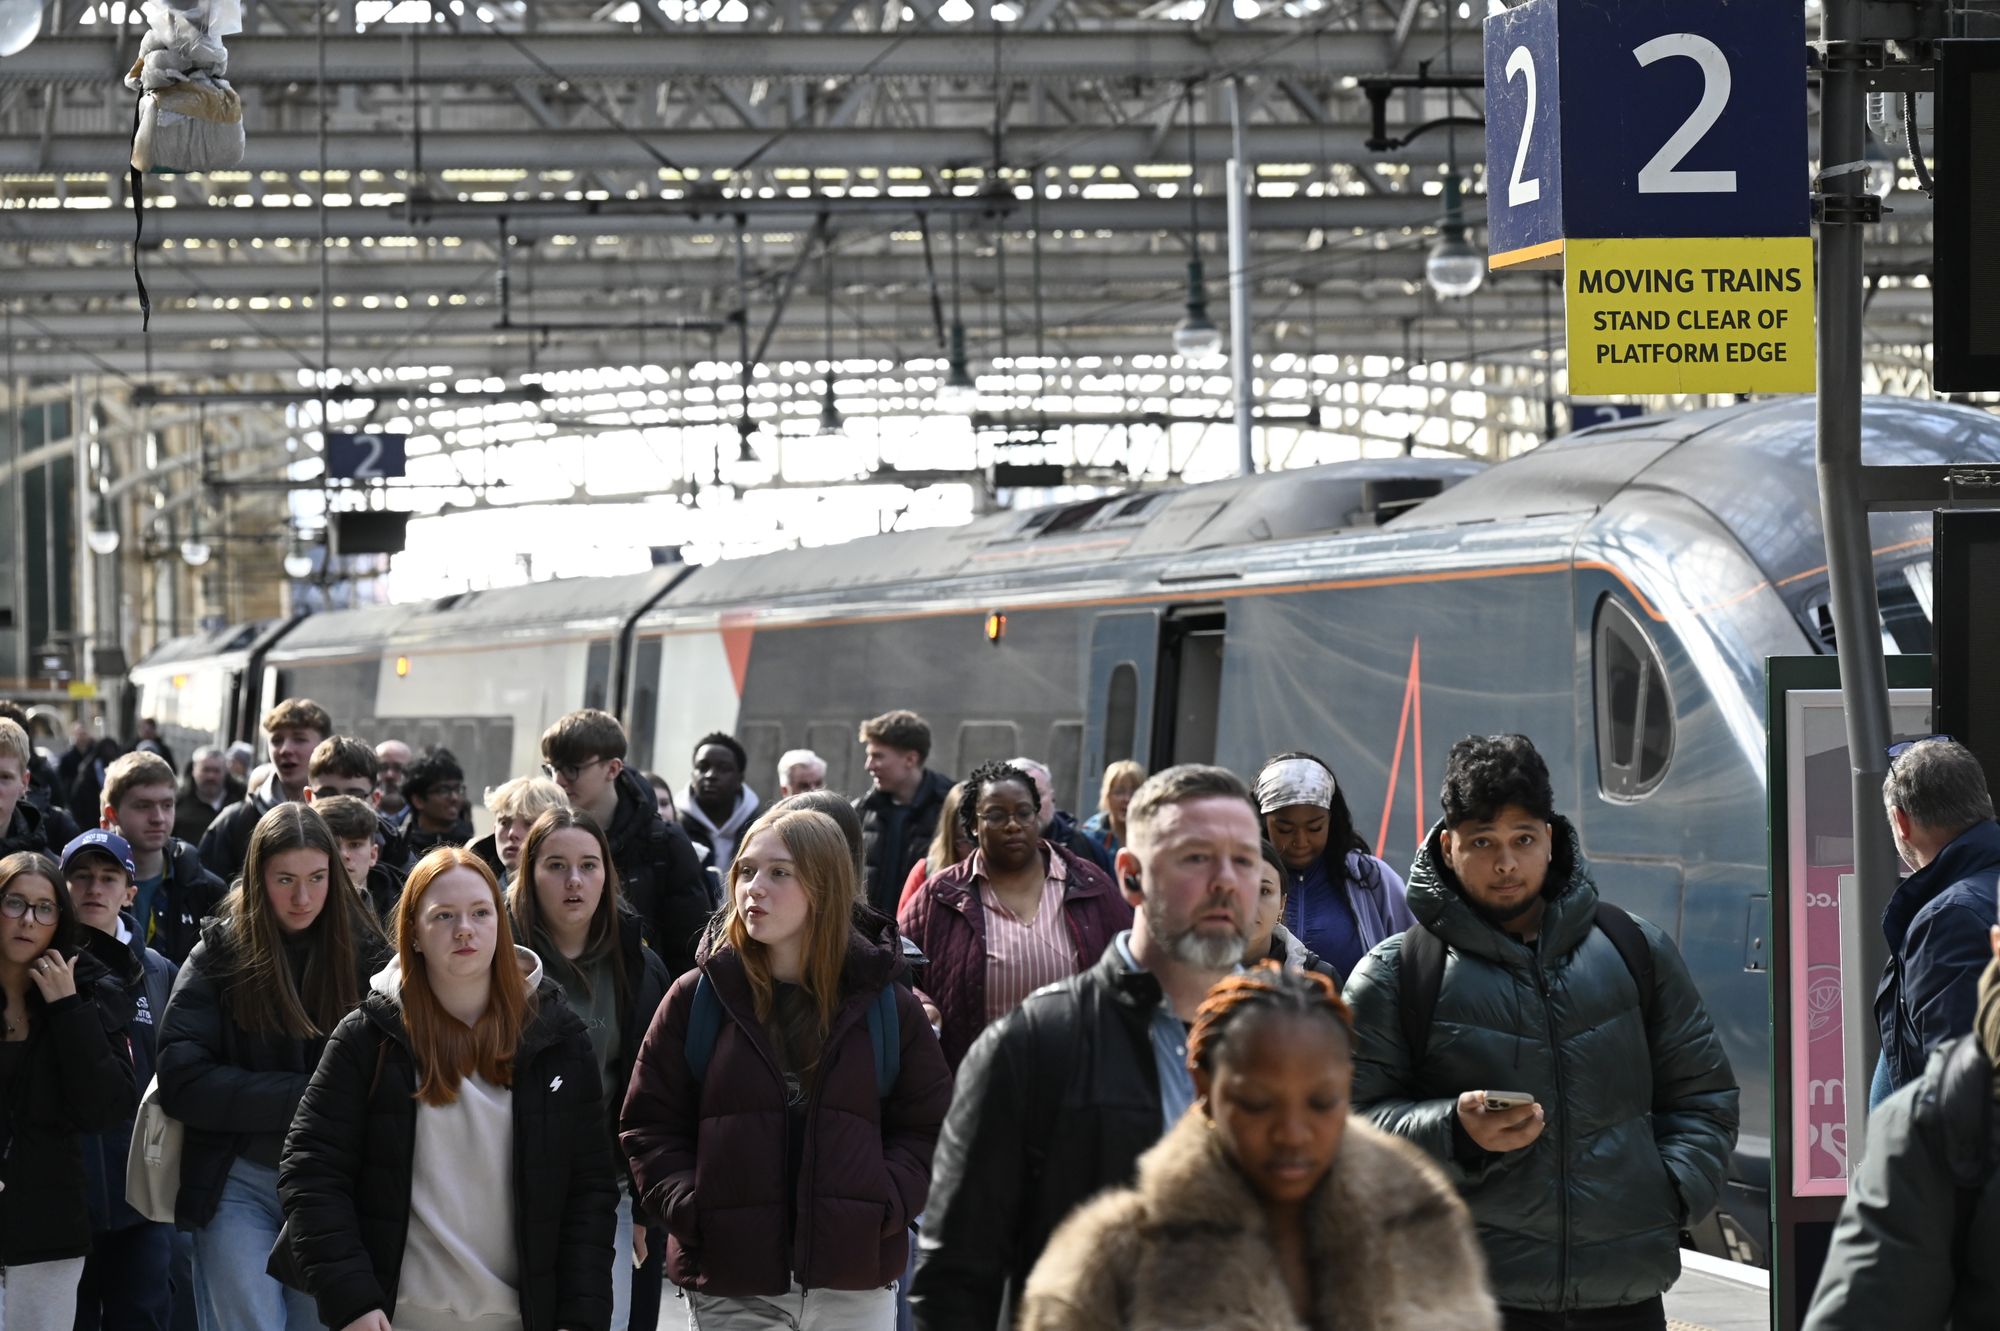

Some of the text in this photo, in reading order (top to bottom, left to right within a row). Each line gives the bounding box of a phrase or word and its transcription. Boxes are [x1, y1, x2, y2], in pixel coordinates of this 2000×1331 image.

[1505, 45, 1540, 207] 2
[1632, 32, 1737, 194] 2
[1578, 267, 1802, 294] MOVING TRAINS
[1593, 309, 1788, 331] STAND CLEAR OF
[1596, 342, 1788, 364] PLATFORM EDGE
[352, 434, 384, 478] 2
